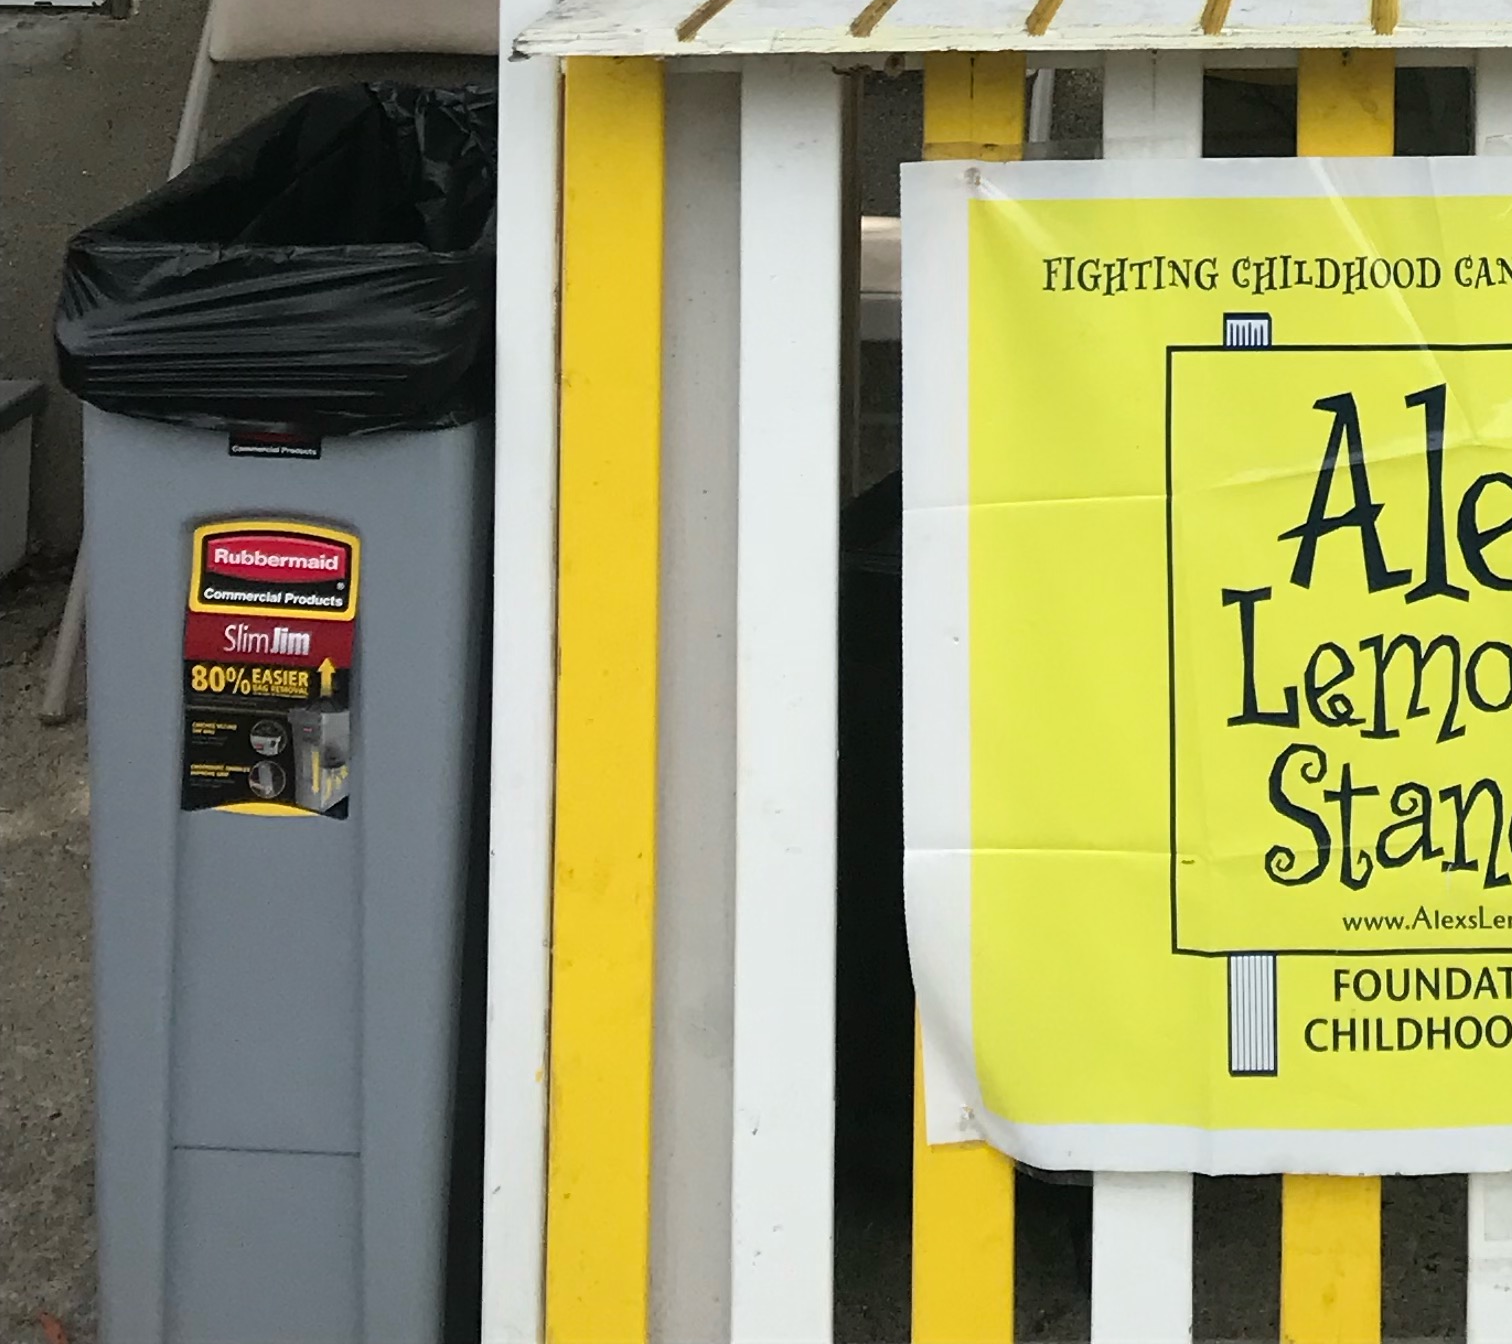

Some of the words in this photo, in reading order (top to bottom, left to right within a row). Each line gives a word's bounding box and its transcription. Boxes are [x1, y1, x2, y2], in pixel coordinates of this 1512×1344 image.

[1042, 254, 1219, 295] FIGHTING
[1231, 253, 1442, 295] CHILDHOOD
[214, 548, 339, 571] Rubbermaid
[203, 587, 282, 604] Commercial
[284, 592, 344, 608] Products
[191, 664, 251, 695] 80%
[251, 668, 309, 687] EASIER
